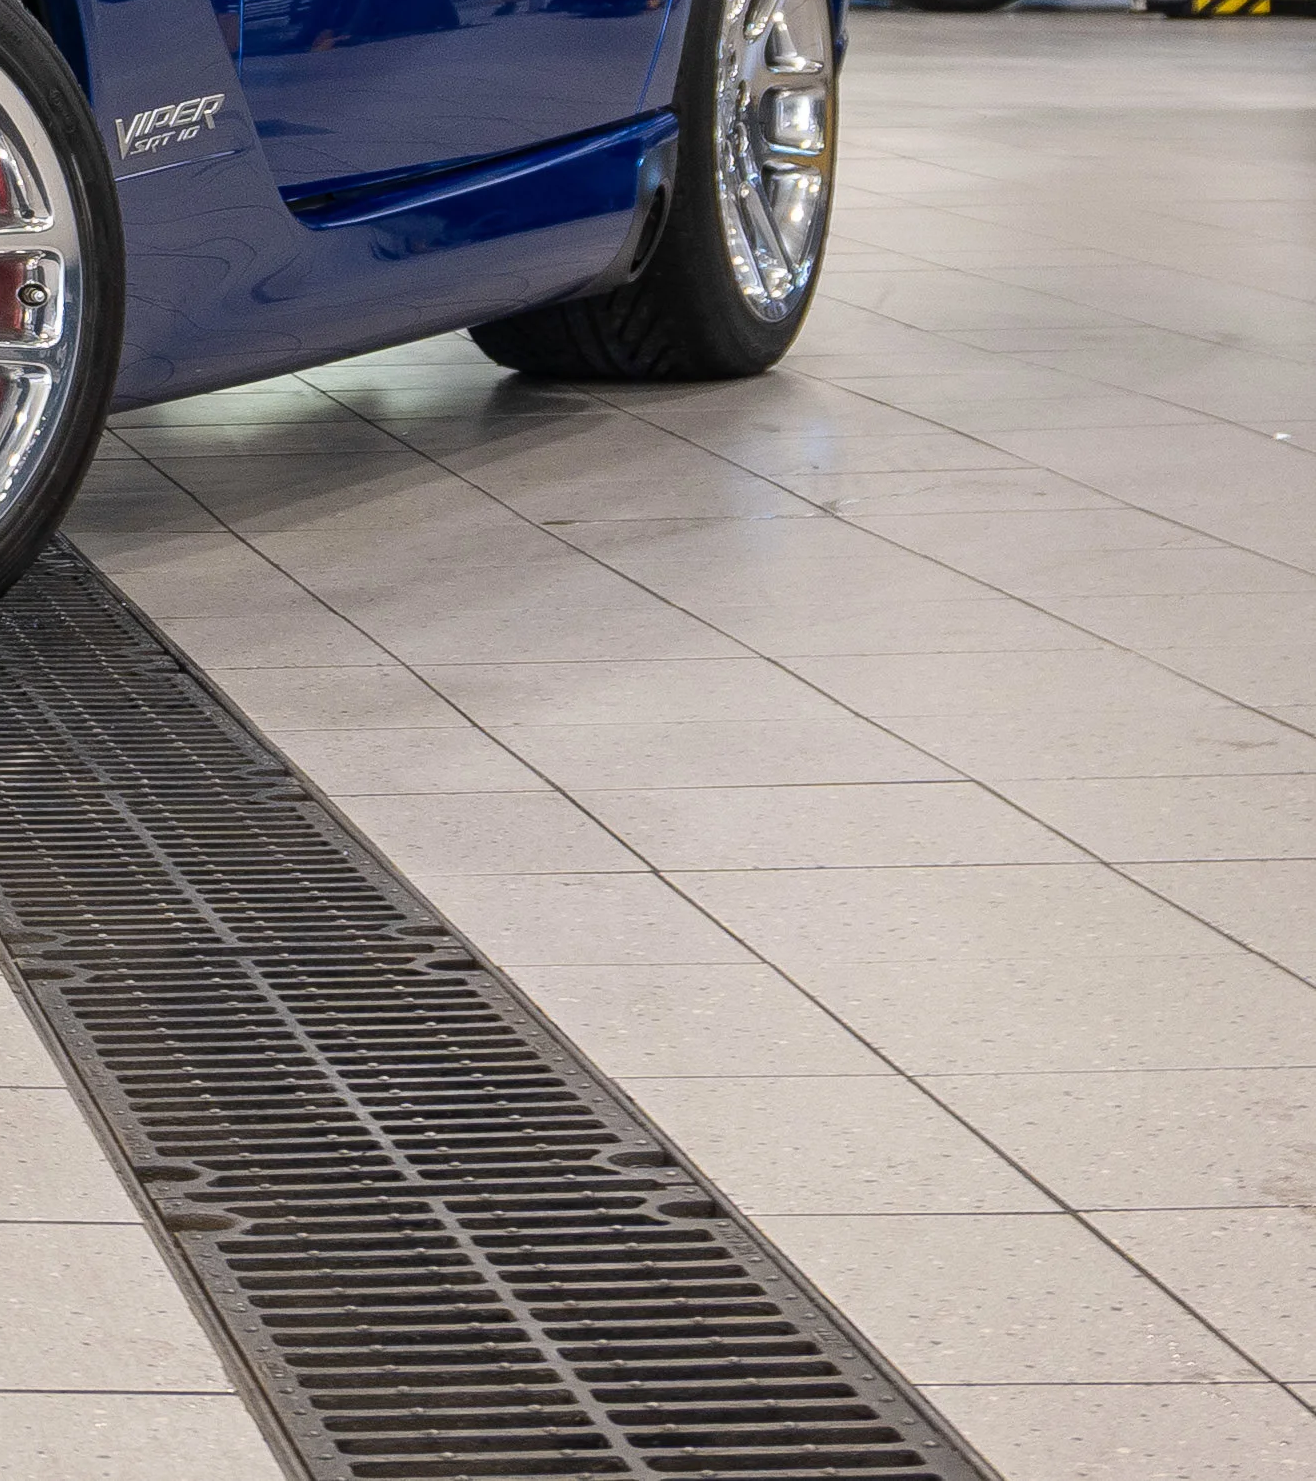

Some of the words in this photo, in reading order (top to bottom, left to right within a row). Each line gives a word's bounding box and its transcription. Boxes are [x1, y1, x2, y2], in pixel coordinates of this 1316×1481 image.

[115, 94, 225, 160] VIPER
[130, 131, 176, 155] SRT
[177, 125, 201, 142] 10
